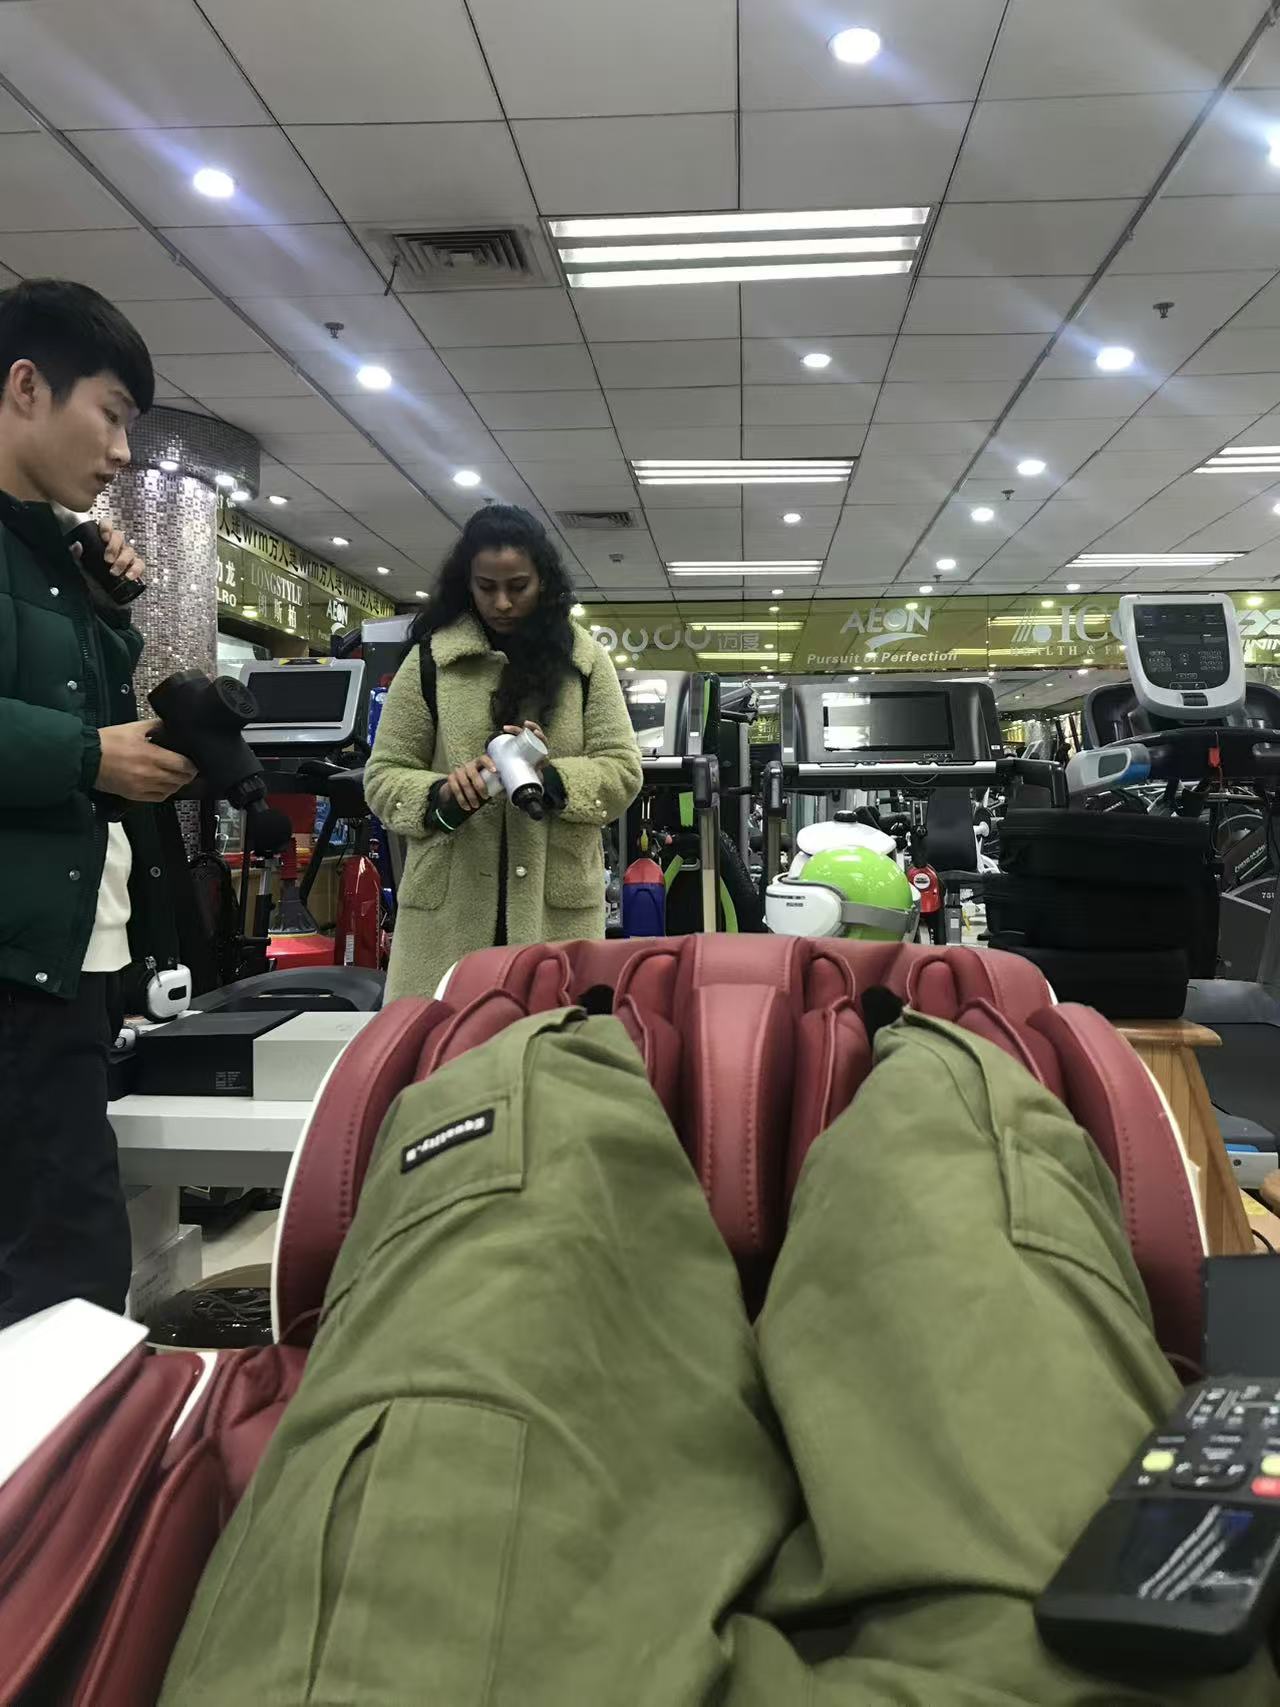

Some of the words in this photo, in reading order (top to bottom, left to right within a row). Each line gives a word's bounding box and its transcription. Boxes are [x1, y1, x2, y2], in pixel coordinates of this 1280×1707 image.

[251, 562, 303, 606] LONGSTYLE
[840, 606, 933, 634] AEON
[807, 653, 860, 665] Pursuit
[881, 650, 958, 663] Perfection
[1087, 644, 1096, 655] &
